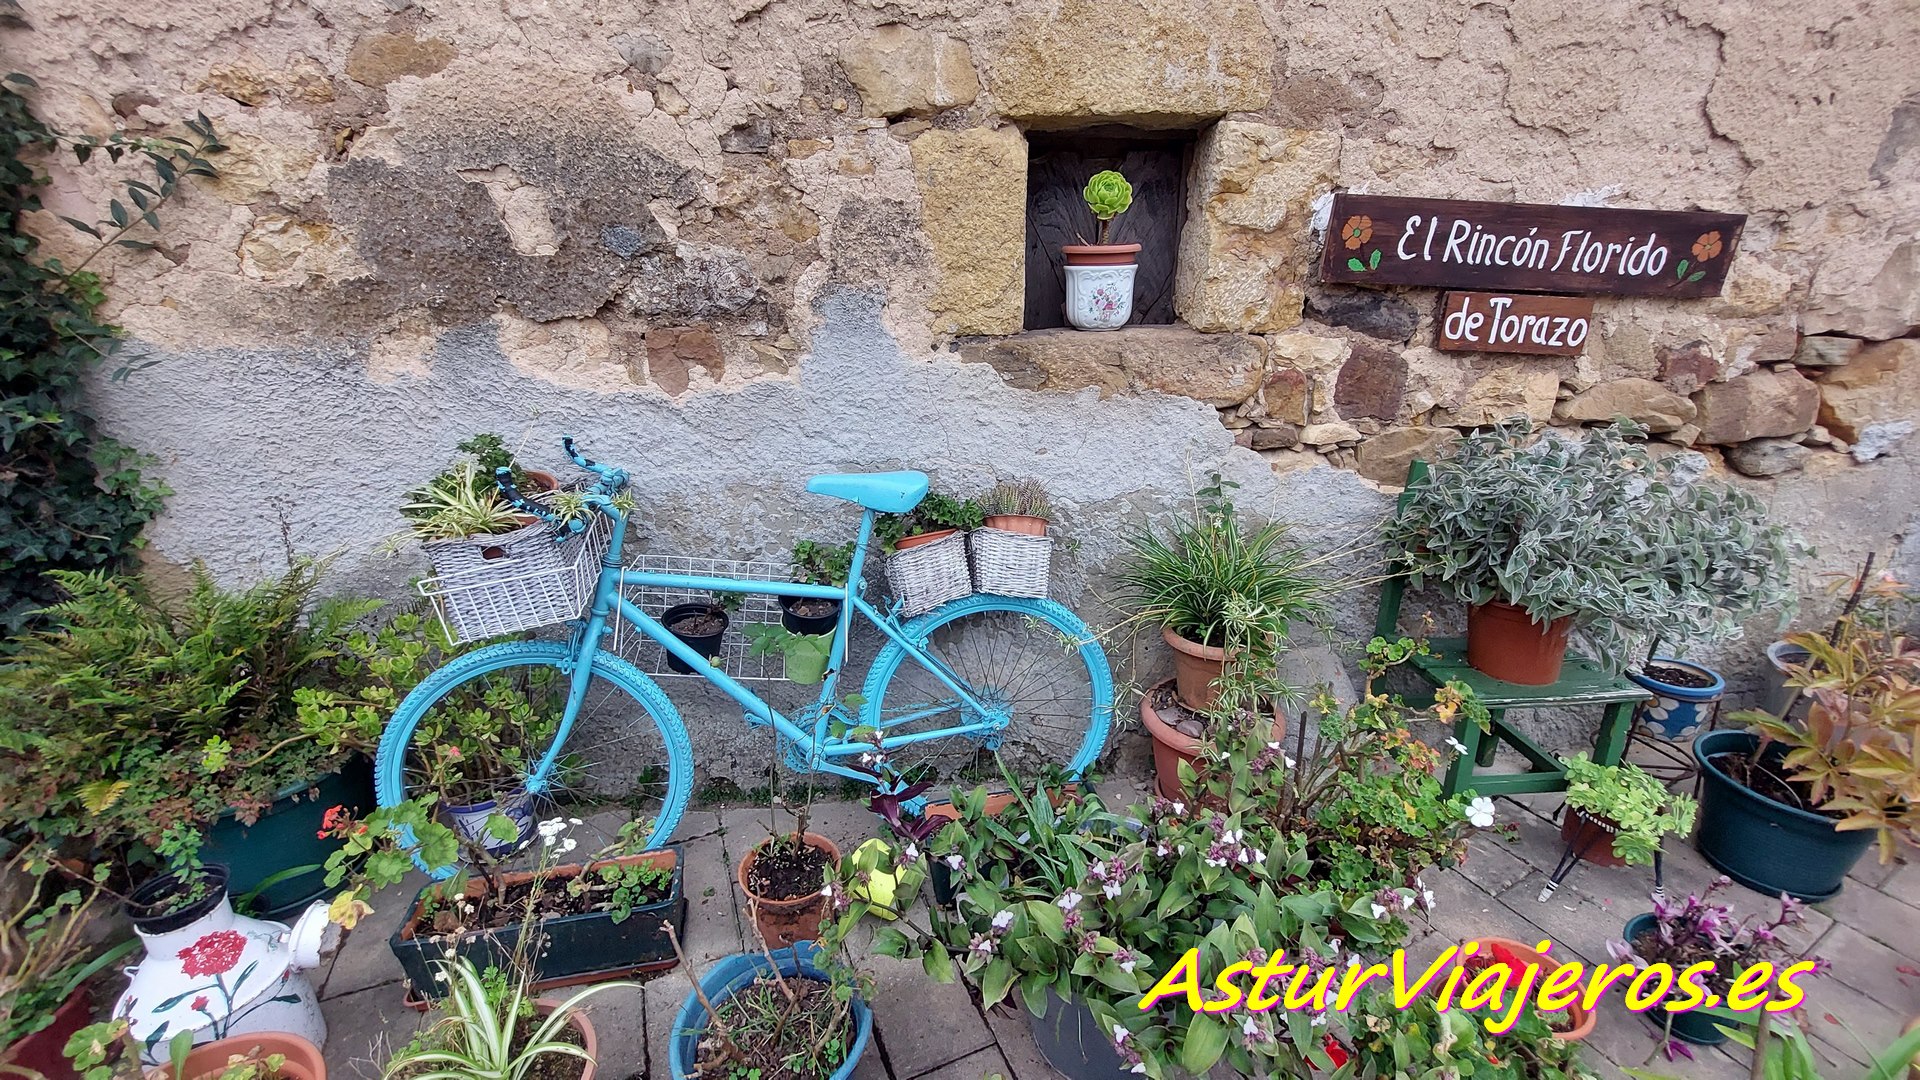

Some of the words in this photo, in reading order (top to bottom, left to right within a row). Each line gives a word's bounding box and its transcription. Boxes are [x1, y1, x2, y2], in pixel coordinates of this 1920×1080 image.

[1397, 214, 1438, 261] El
[1442, 219, 1550, 270] Rincón
[1550, 229, 1668, 277] Florido
[1444, 296, 1484, 342] de
[1488, 297, 1588, 347] Torazo
